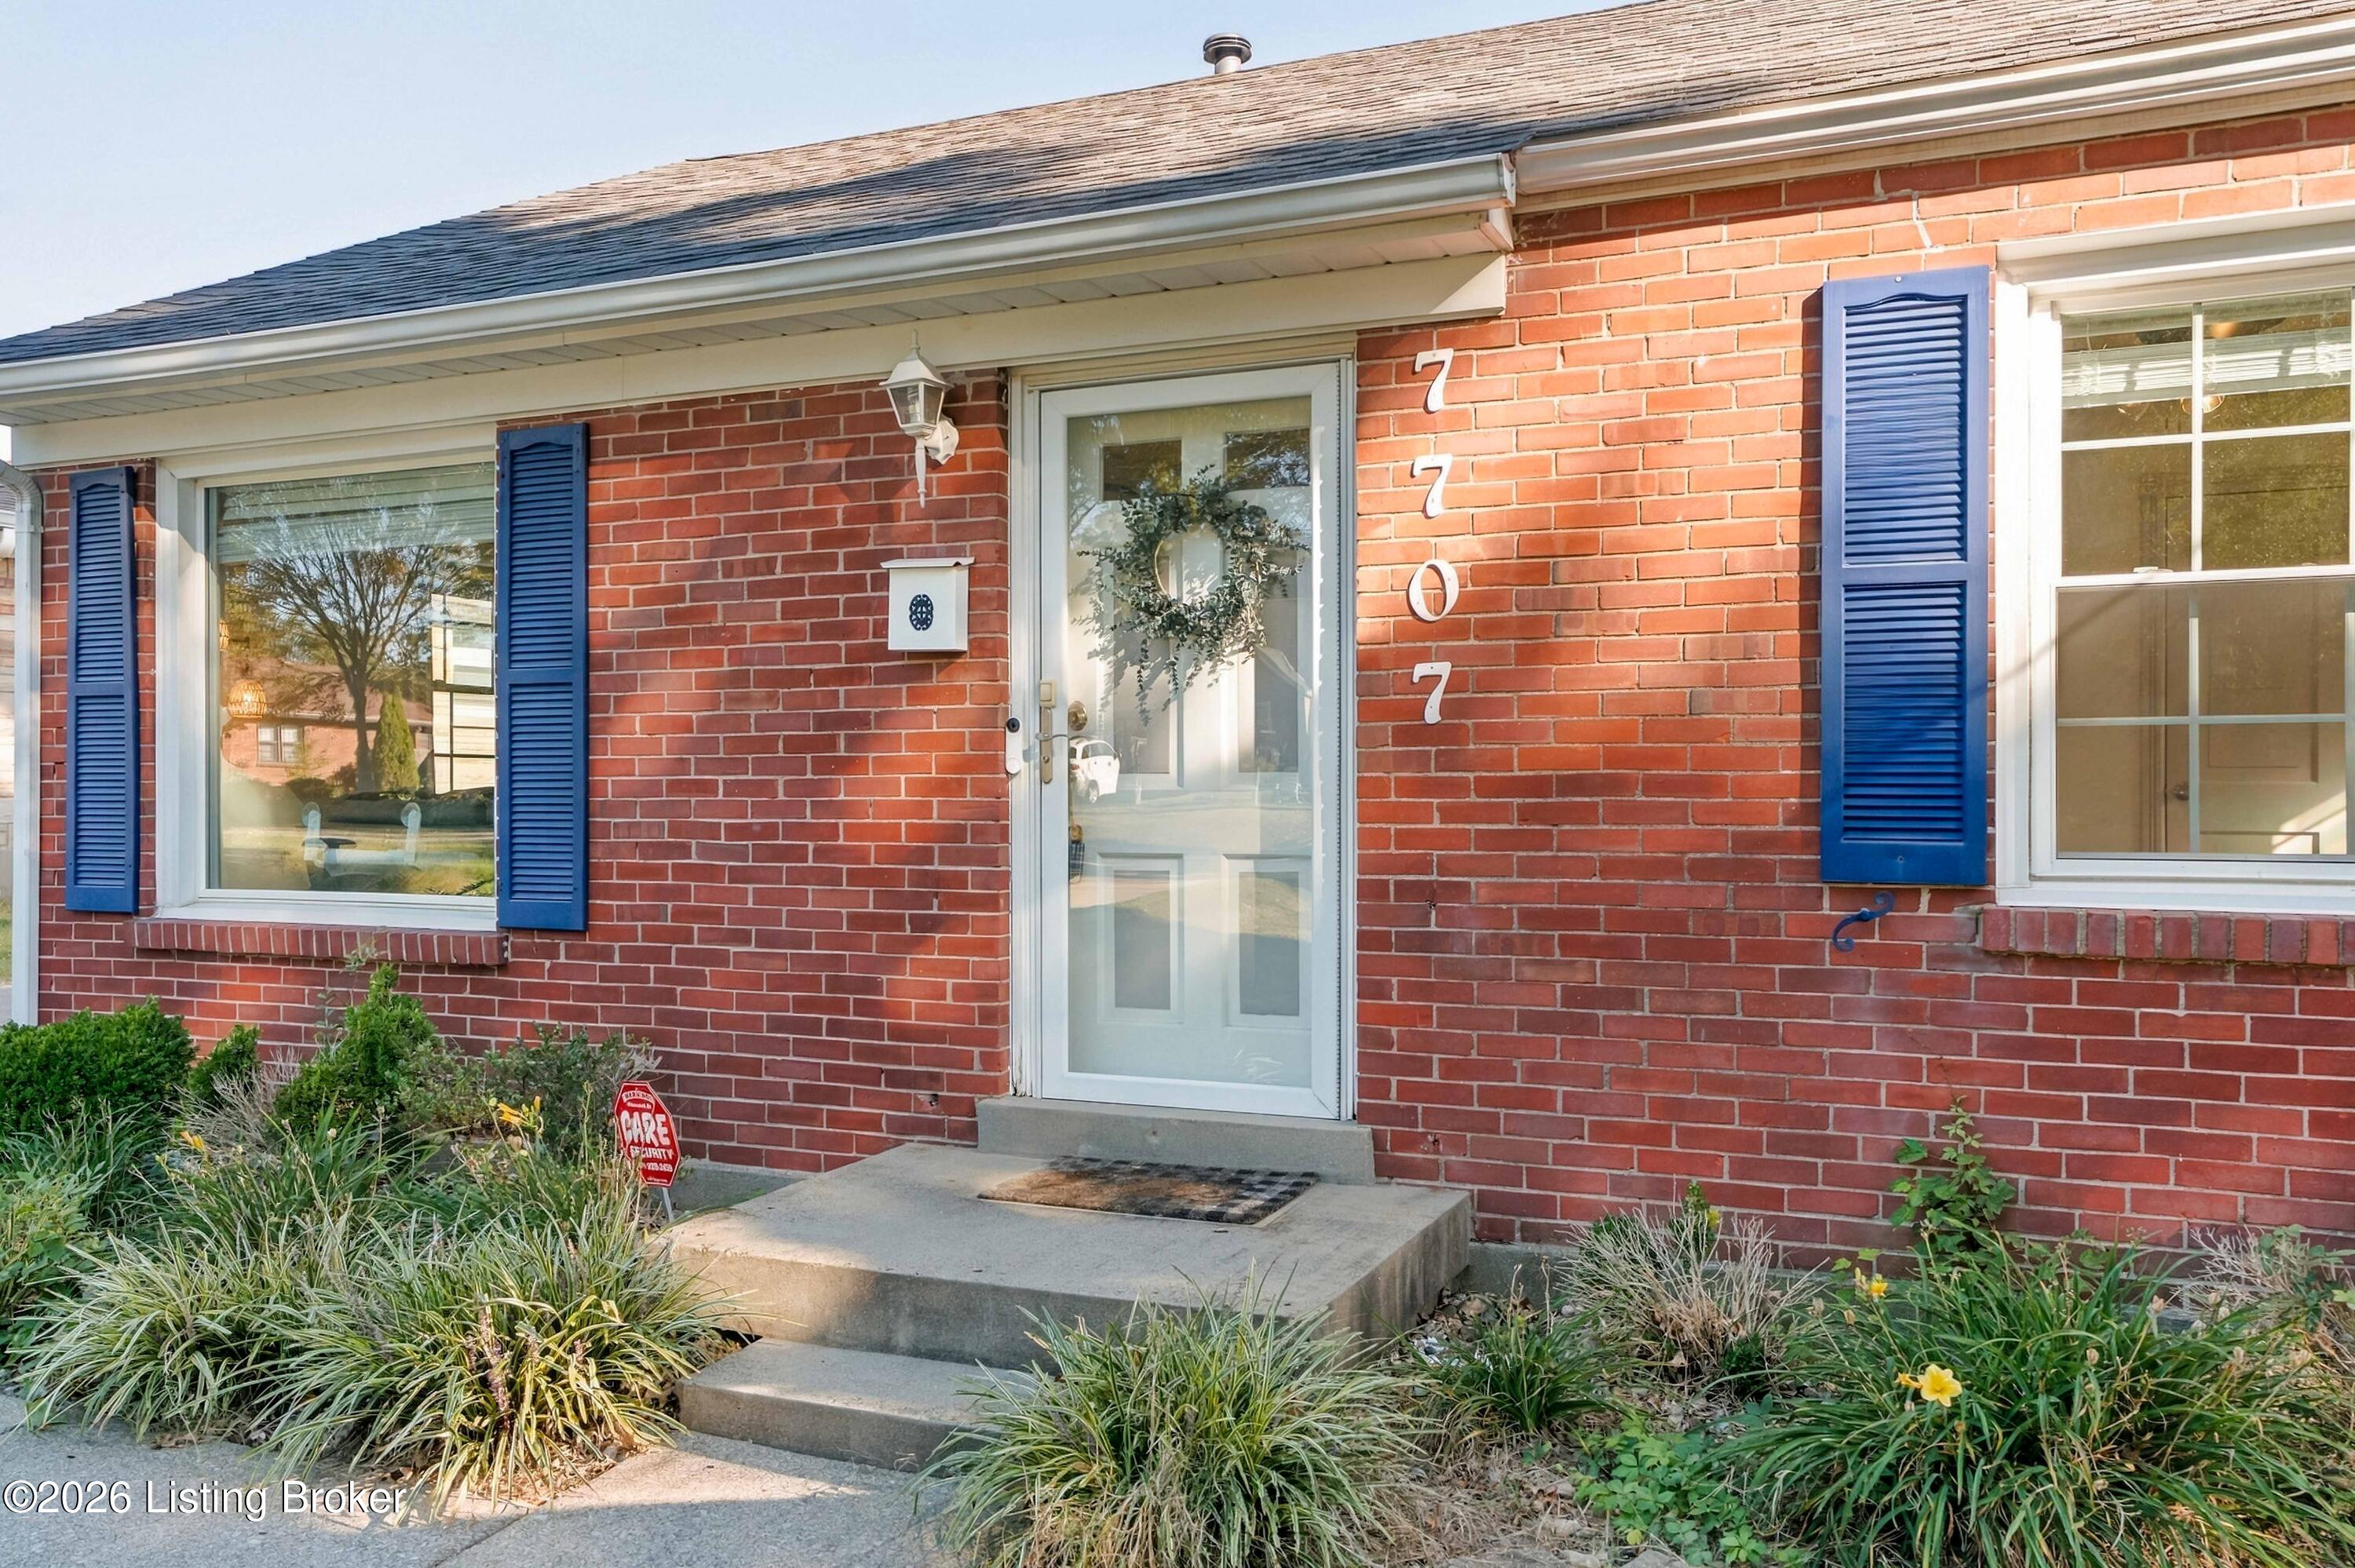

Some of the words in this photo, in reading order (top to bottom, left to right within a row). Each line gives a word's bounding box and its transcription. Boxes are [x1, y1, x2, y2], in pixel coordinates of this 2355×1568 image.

[1408, 348, 1460, 725] 7707
[620, 1110, 670, 1147] CARE
[630, 1145, 674, 1160] SECURITY
